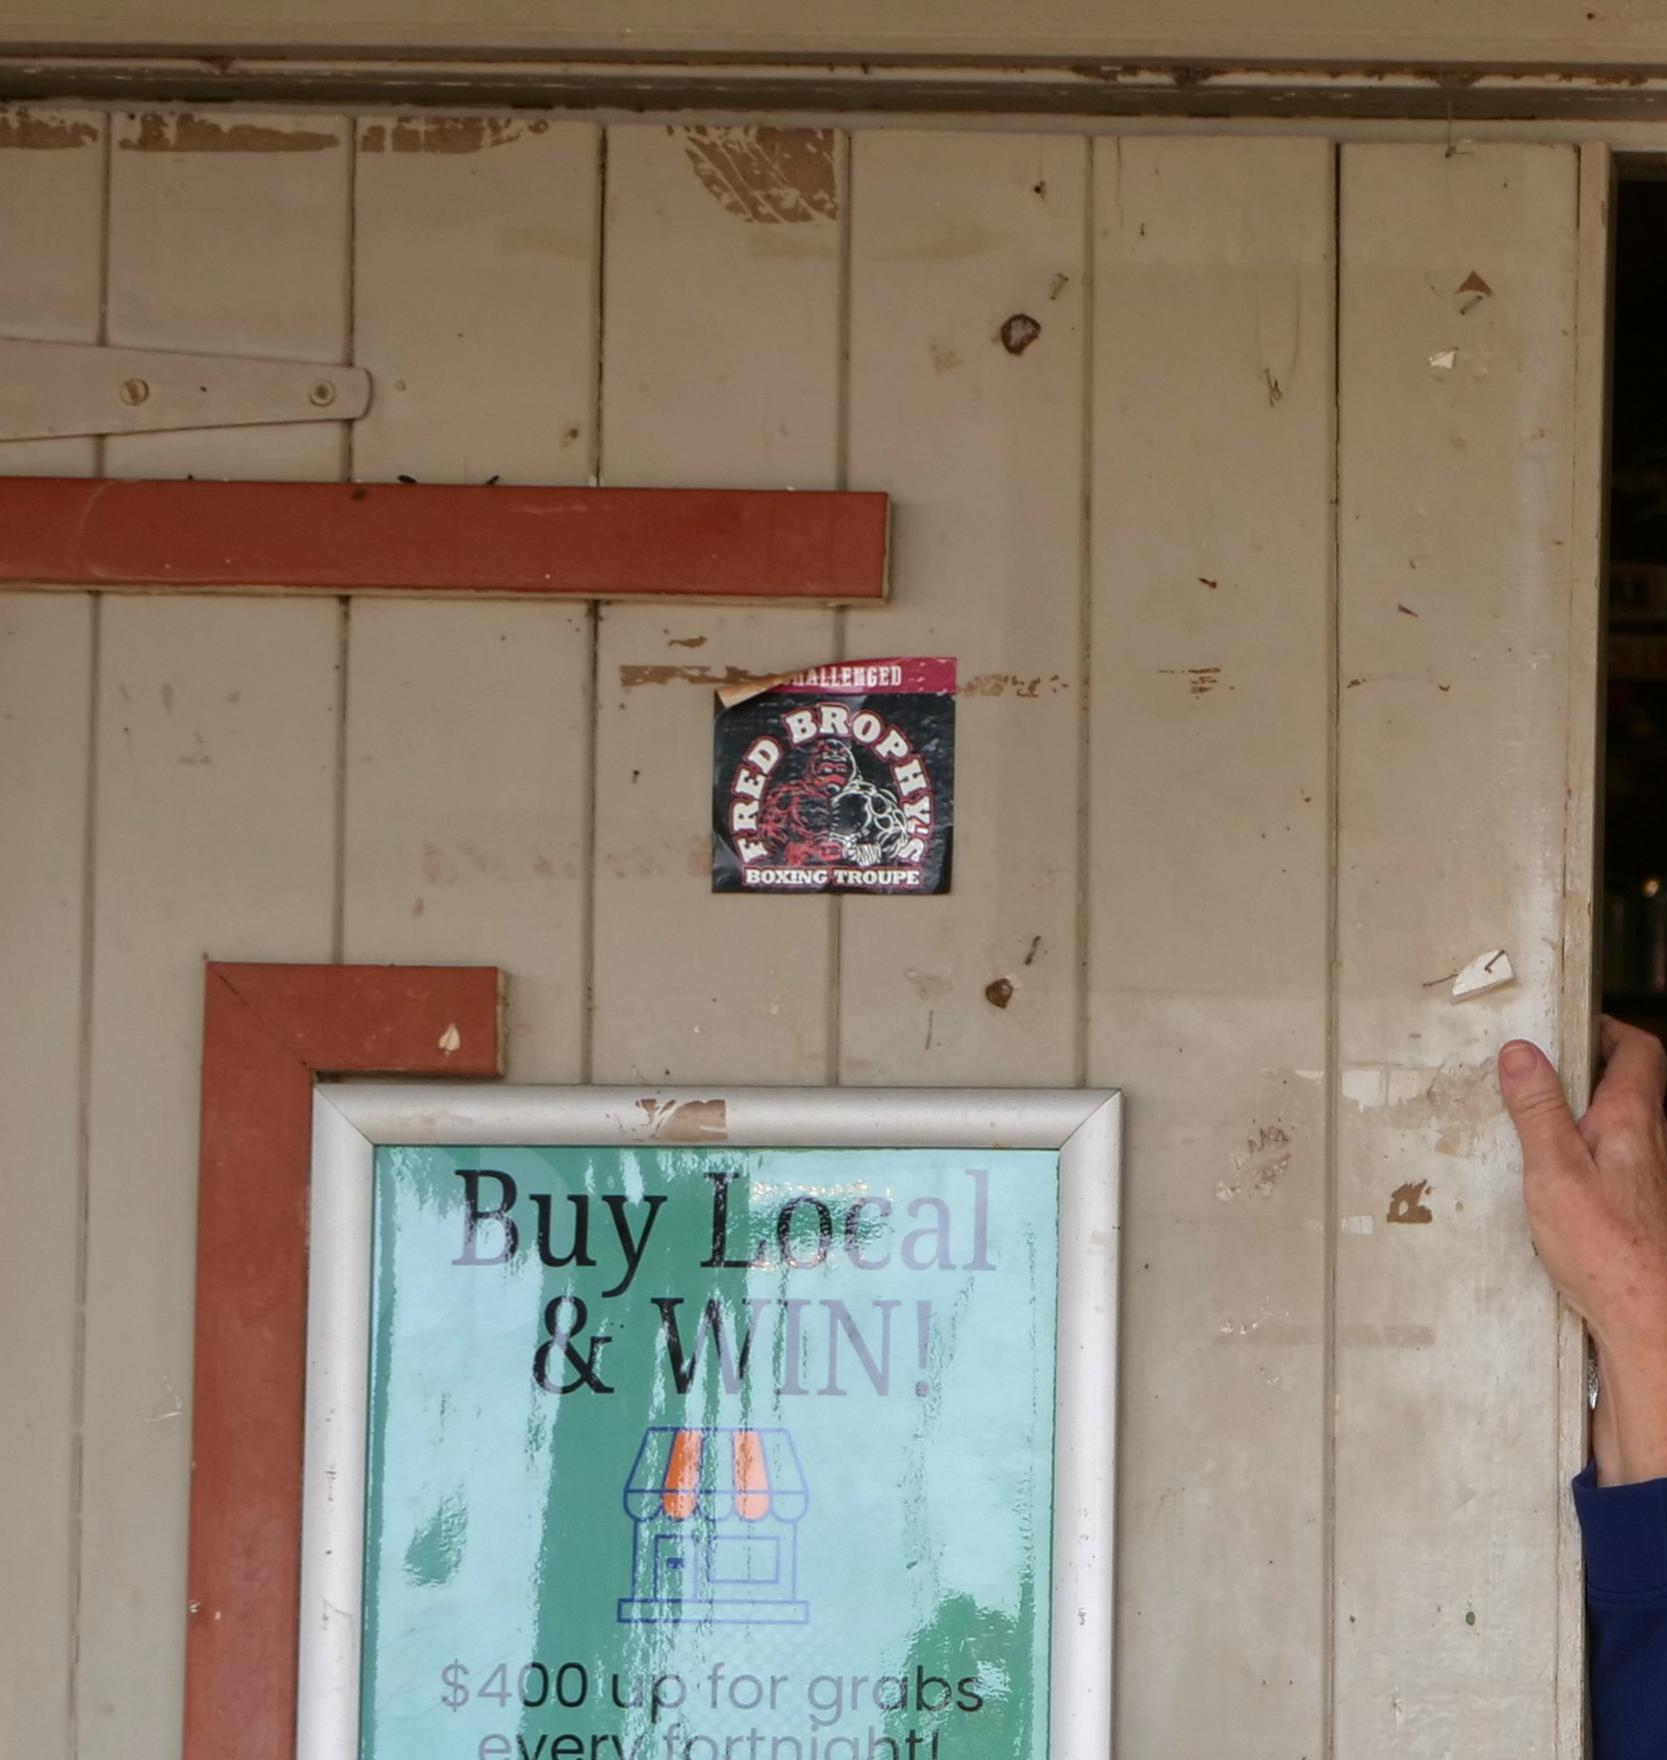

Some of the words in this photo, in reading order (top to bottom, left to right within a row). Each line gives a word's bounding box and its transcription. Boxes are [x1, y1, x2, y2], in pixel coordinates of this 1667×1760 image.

[784, 664, 901, 687] HALLENGED
[731, 737, 784, 864] FRED
[745, 868, 828, 885] BOXING
[833, 868, 921, 886] TROUPE
[452, 1169, 668, 1297] Buy
[700, 1169, 997, 1271] Local
[532, 1295, 615, 1396] &
[650, 1298, 930, 1398] WIN!
[440, 1659, 589, 1711] $400
[612, 1675, 687, 1725] up
[707, 1661, 788, 1710] for
[807, 1665, 984, 1727] grabs
